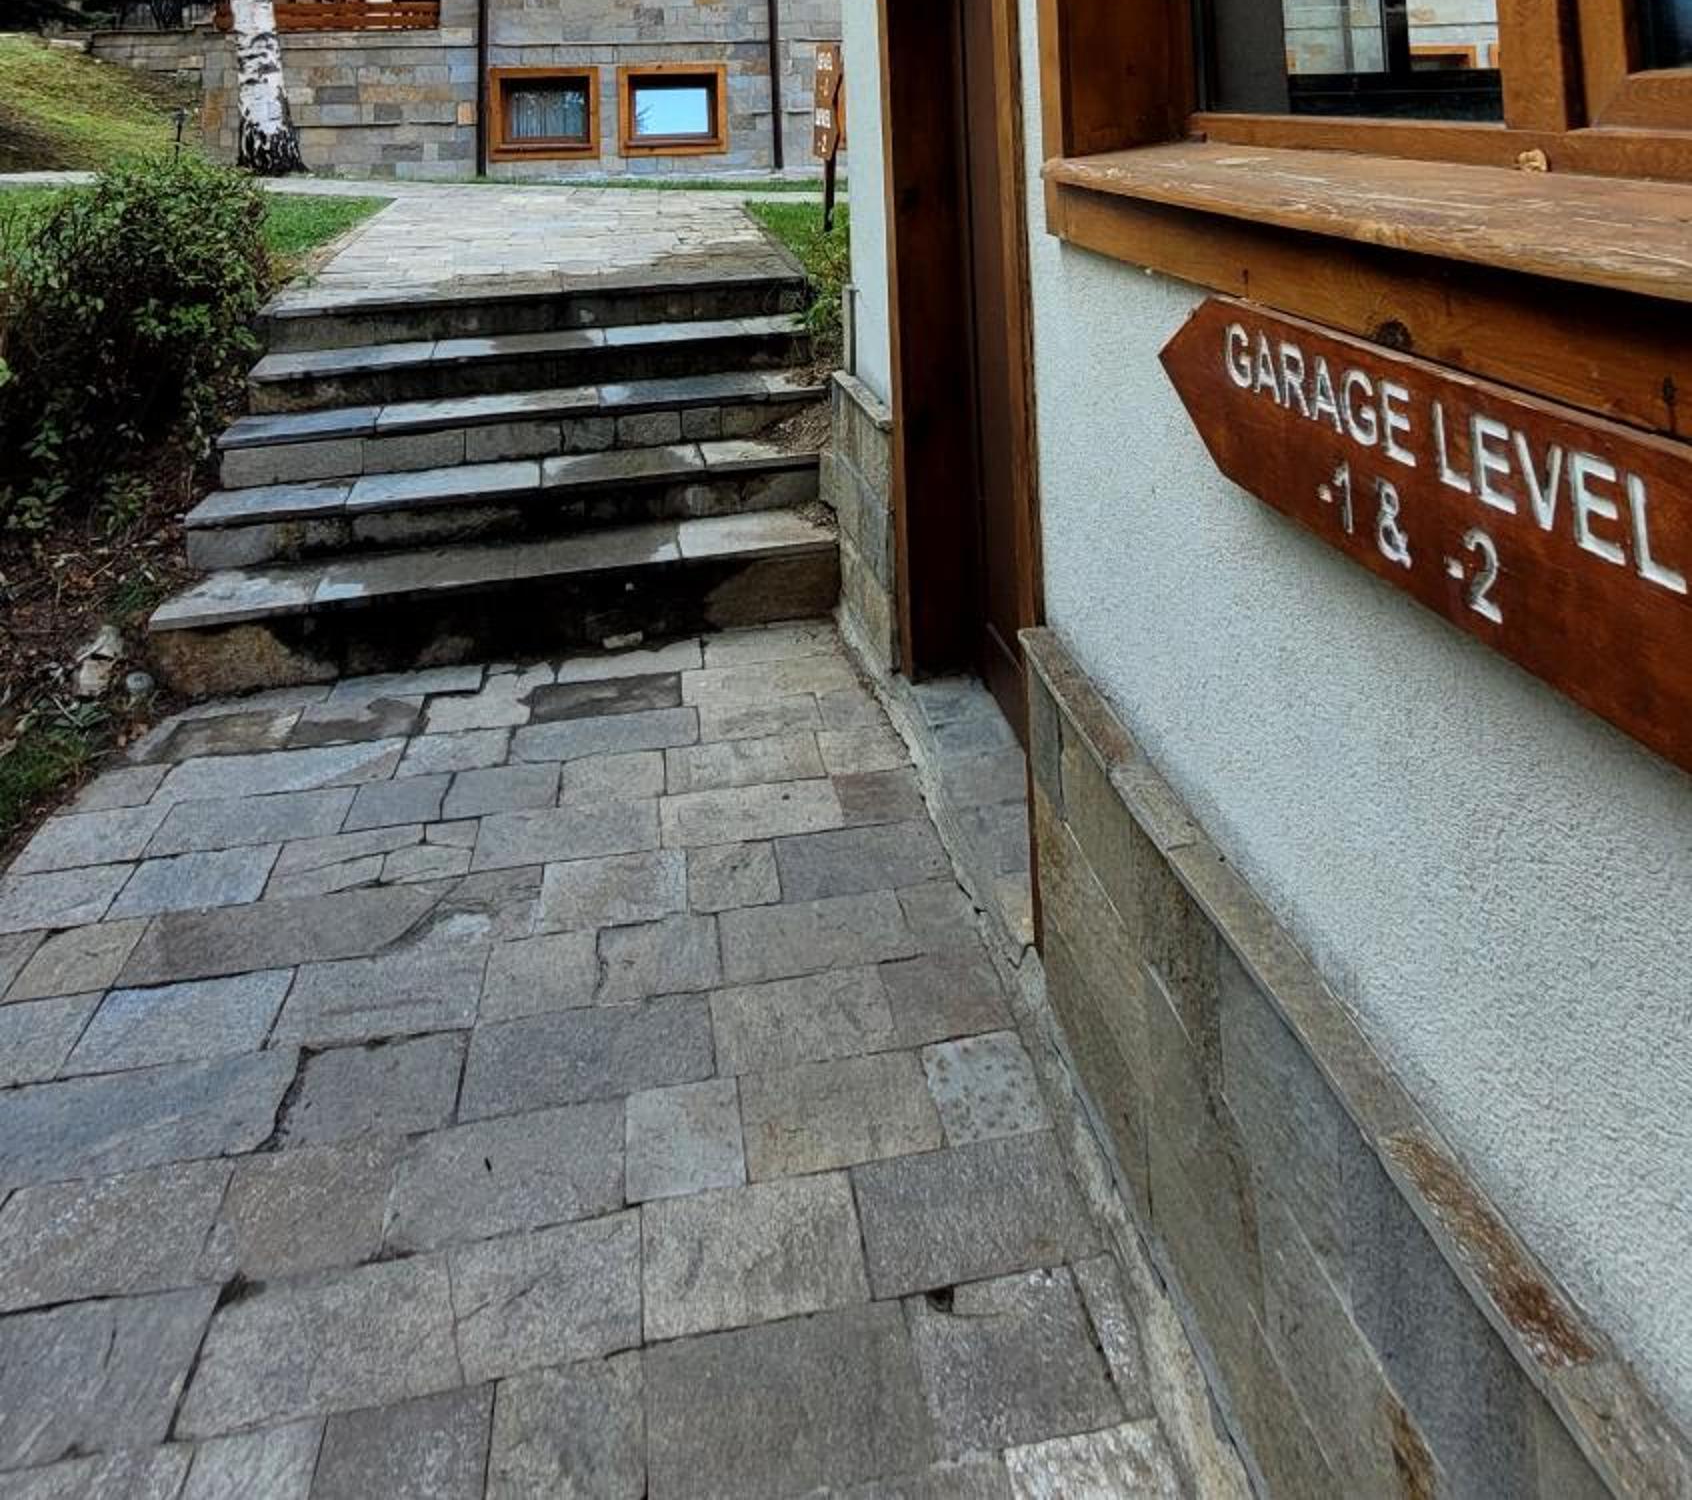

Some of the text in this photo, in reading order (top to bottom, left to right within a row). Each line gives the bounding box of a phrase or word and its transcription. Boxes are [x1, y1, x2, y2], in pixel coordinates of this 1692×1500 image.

[1224, 322, 1688, 595] GARAGE LEVEL
[1318, 460, 1503, 625] -1 & -2
